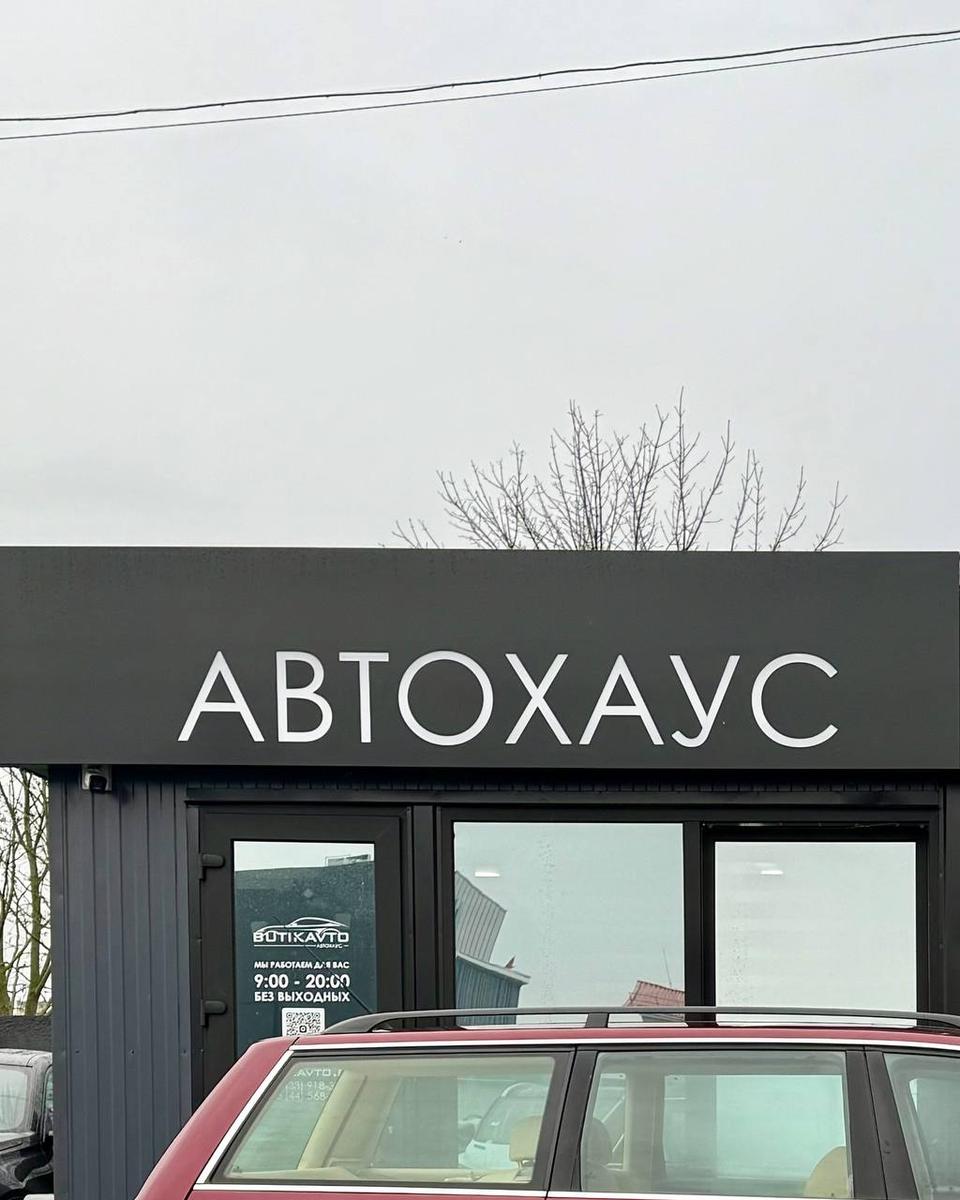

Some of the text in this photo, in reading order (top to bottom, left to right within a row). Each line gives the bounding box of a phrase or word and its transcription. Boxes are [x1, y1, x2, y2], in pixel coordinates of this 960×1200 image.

[178, 650, 840, 749] АВТОХАУС
[253, 931, 350, 943] BUTIKAVTO
[254, 961, 268, 969] МЫ
[270, 961, 313, 969] РАБОТАЕМ
[332, 961, 350, 969] ВАС
[254, 974, 289, 989] 9:00
[305, 974, 350, 989] 20:00
[254, 991, 350, 1003] БЕЗ ВЫХОДНЫХ
